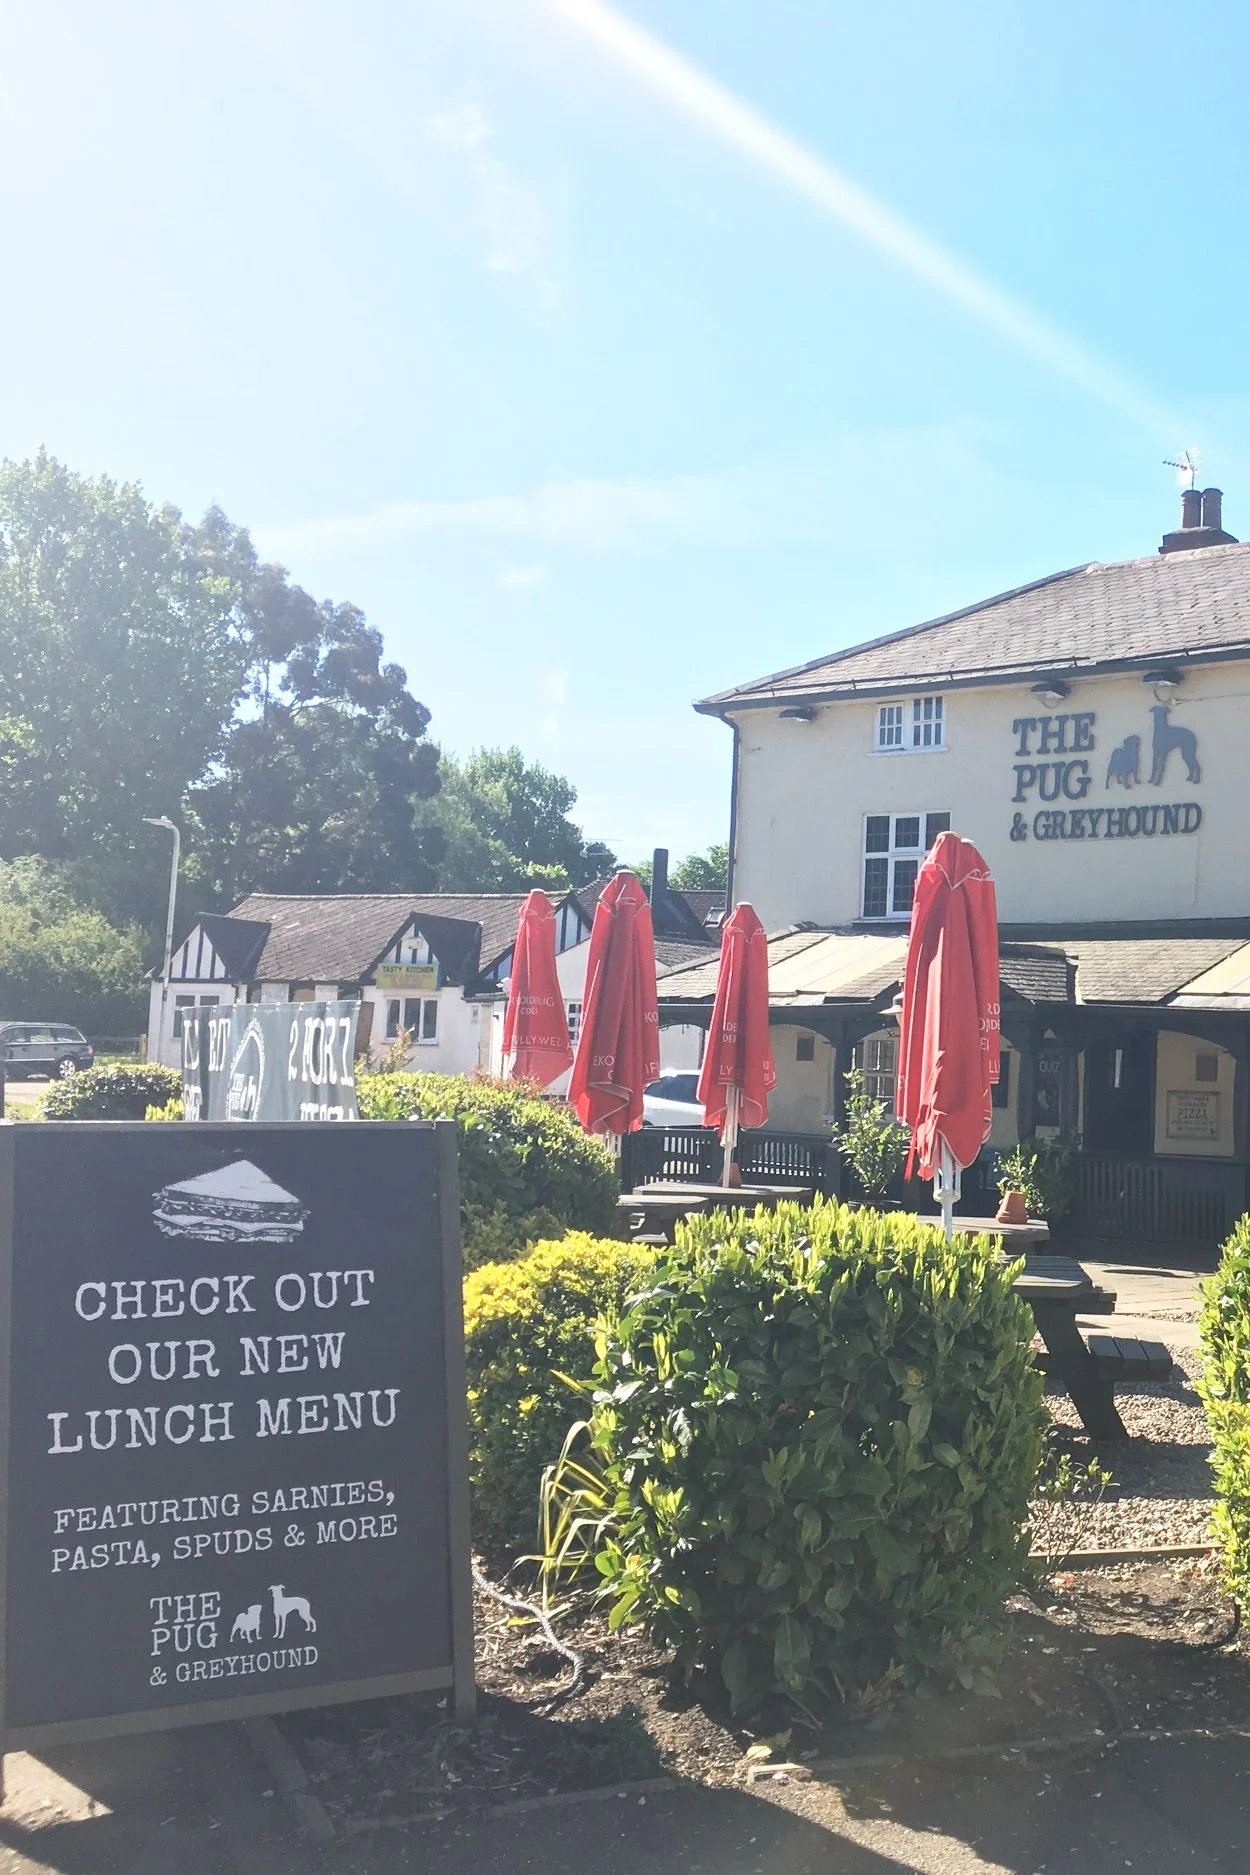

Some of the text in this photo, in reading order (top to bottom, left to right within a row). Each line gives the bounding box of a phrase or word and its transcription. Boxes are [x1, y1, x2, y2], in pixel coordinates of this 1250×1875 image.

[1012, 712, 1096, 757] THE
[1011, 760, 1092, 803] PUG
[1010, 803, 1202, 842] & GREYHOUND
[288, 1019, 299, 1082] 2
[302, 1017, 338, 1085] FOR
[1039, 1060, 1060, 1073] QUIZ
[1178, 1108, 1208, 1119] PIZZA
[75, 1270, 375, 1321] CHECK OUT
[108, 1332, 346, 1384] OUR NEW
[46, 1388, 401, 1454] LUNCH MENU
[53, 1480, 396, 1534] FEATURING SARNIES,
[51, 1514, 399, 1573] PASTA, SPUDS & MORE
[150, 1592, 221, 1625] THE
[150, 1621, 219, 1656] PUG
[149, 1646, 319, 1686] & GREYHOUND
